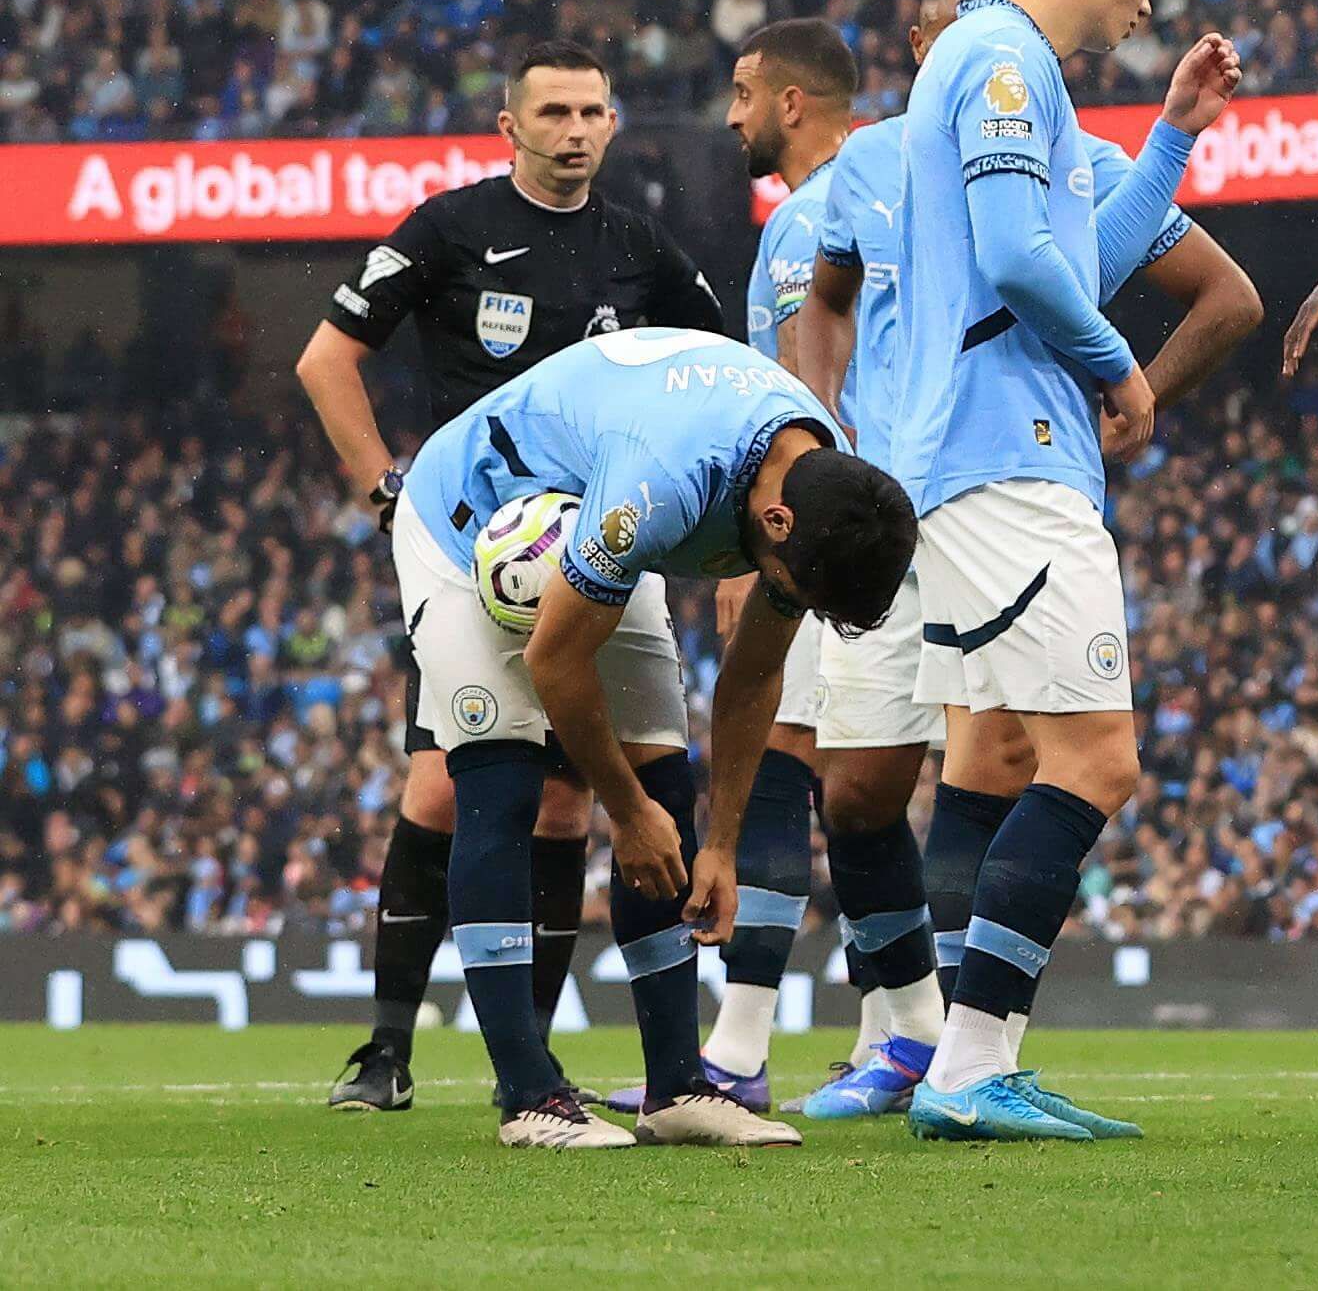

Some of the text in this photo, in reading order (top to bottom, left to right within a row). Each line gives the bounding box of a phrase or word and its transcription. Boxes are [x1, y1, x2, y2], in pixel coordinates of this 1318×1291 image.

[981, 119, 1029, 131] No room
[68, 148, 516, 234] A global tech
[485, 296, 525, 315] FIFA
[482, 320, 525, 333] REFEREE
[664, 363, 800, 397] DOĞAN
[596, 551, 624, 577] room
